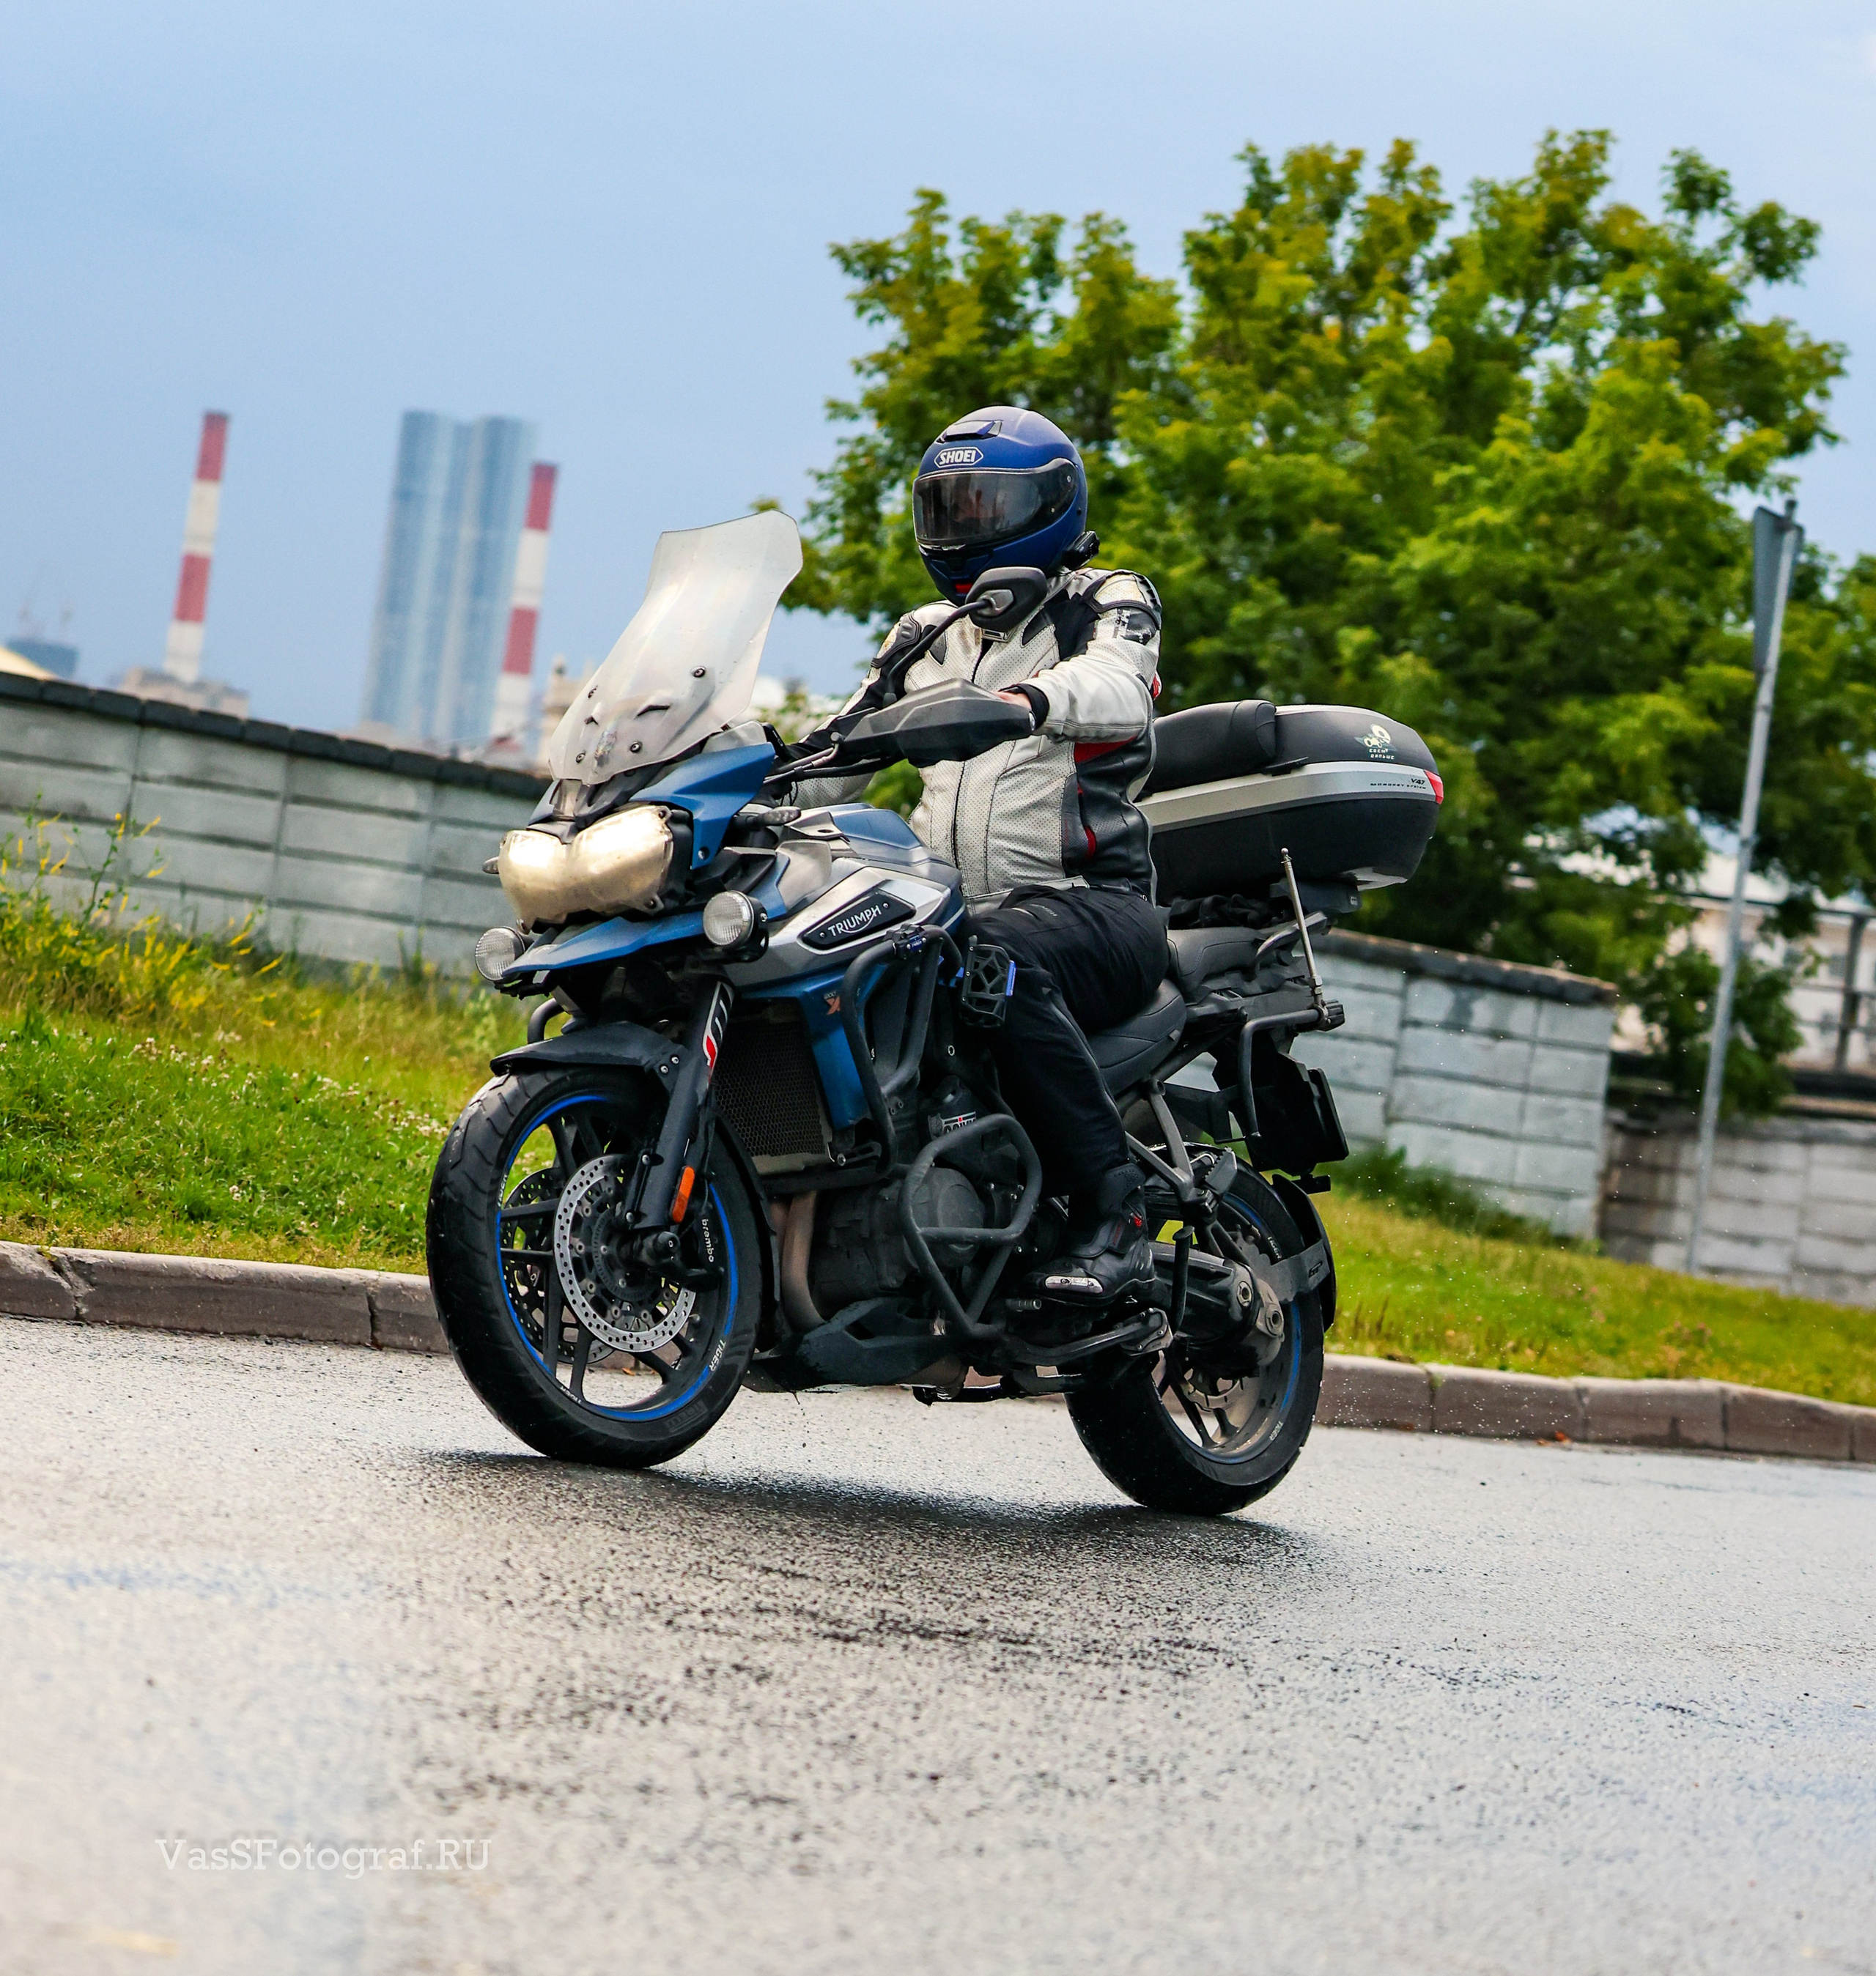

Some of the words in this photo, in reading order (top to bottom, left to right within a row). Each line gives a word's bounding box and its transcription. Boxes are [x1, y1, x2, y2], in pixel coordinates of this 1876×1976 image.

[939, 449, 976, 465] SHOEI
[827, 905, 882, 936] TRIUMPH
[701, 1218, 714, 1262] brembo
[709, 1339, 726, 1372] TIGER
